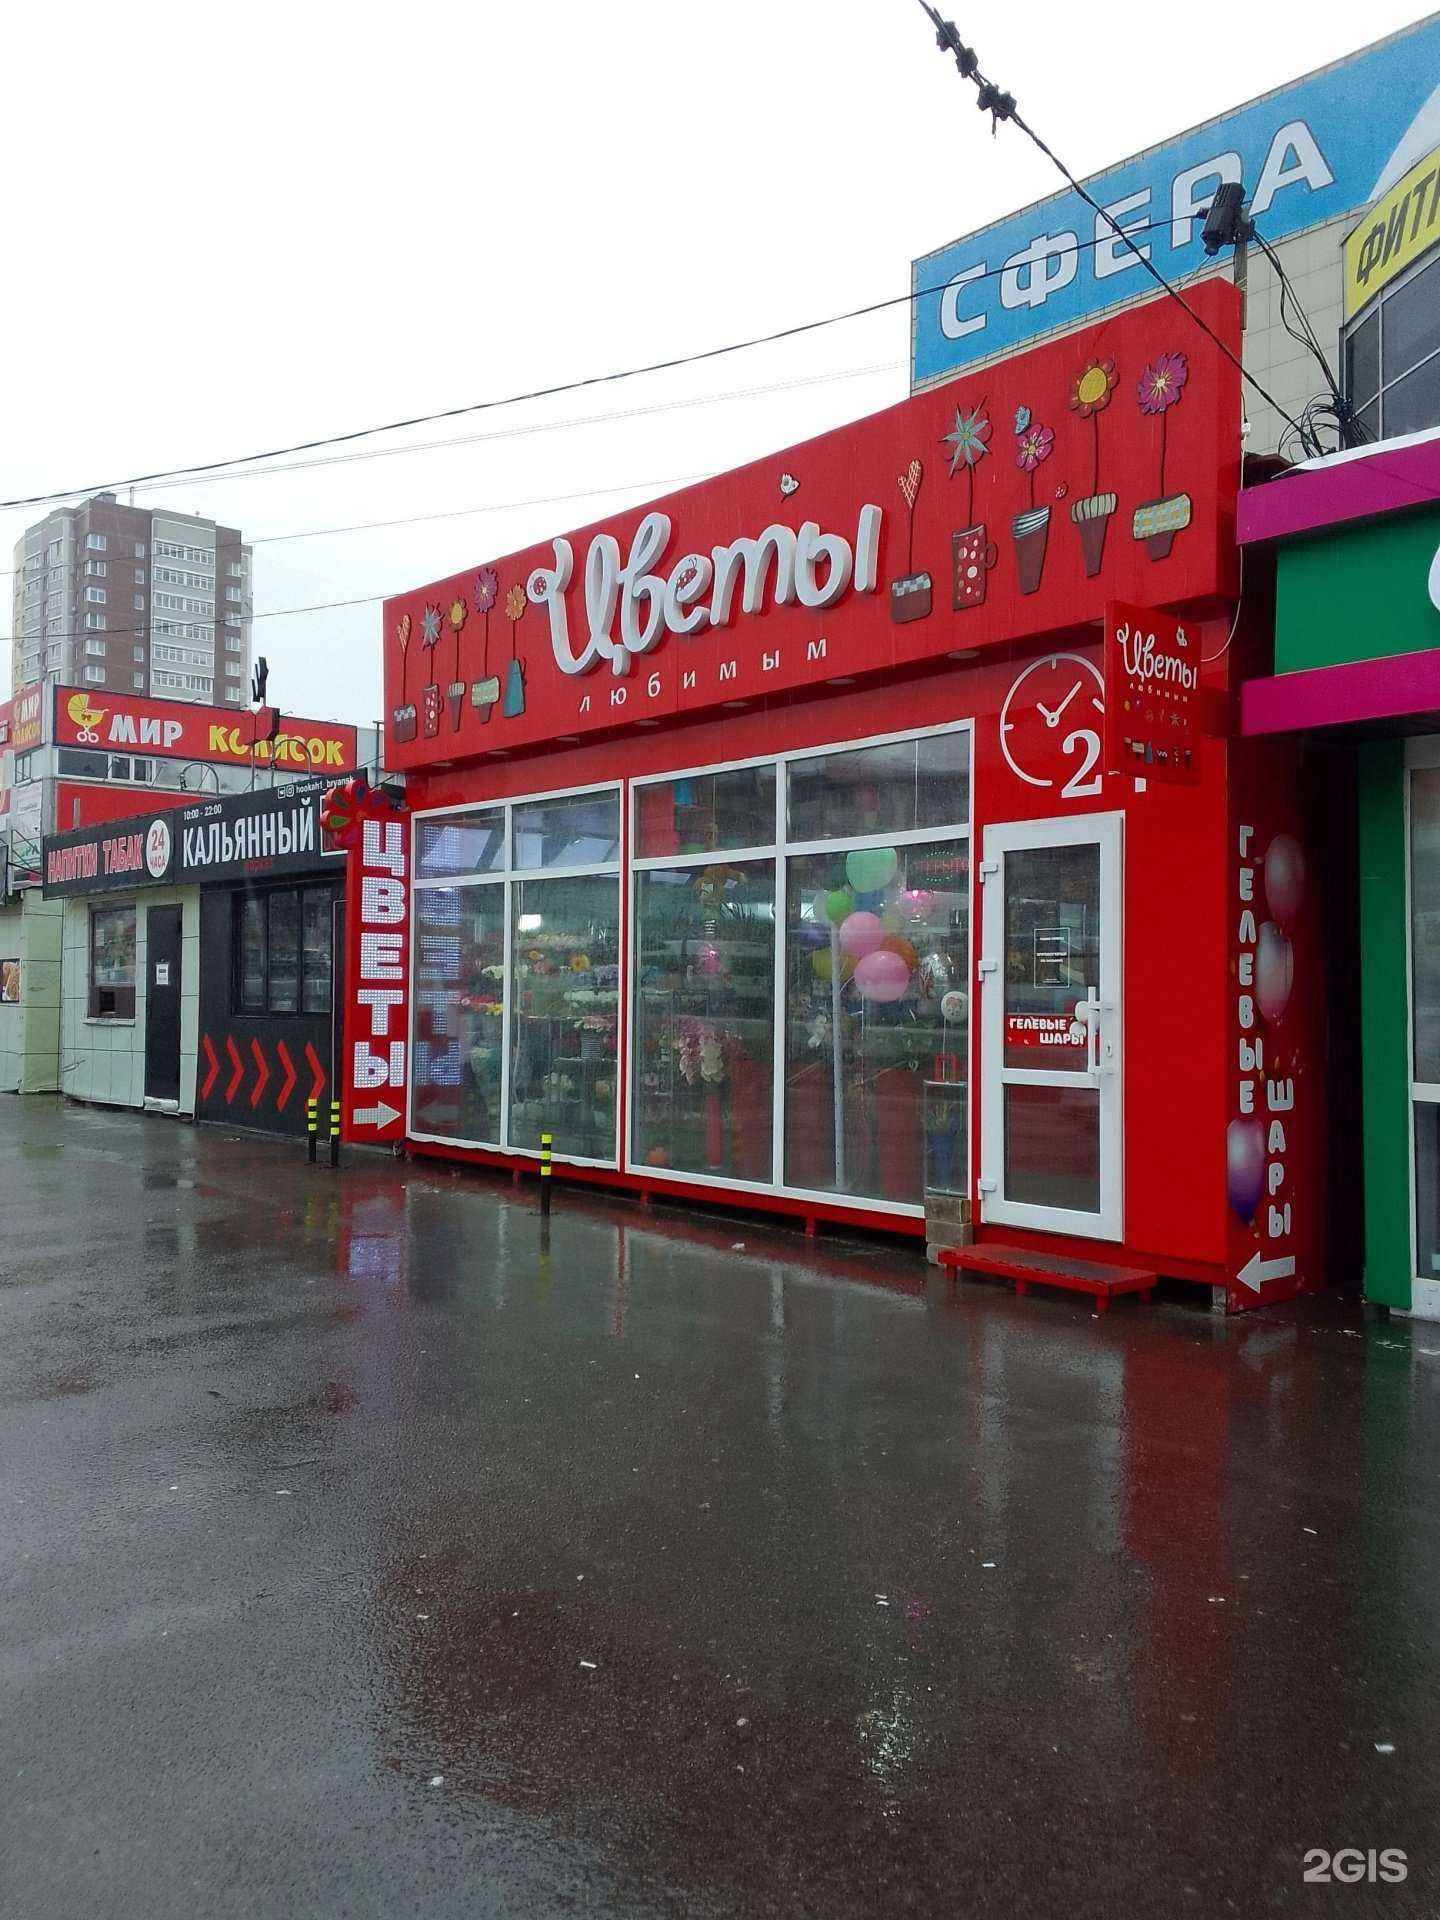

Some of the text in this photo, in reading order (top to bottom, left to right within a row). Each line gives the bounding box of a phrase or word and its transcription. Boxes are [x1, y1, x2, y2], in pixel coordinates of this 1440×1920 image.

[940, 119, 1335, 340] СФЕРА
[526, 503, 883, 677] Цветы
[1116, 621, 1198, 691] Цветы
[108, 713, 183, 748] МИР
[102, 833, 143, 875] ТАБАК
[151, 829, 165, 851] 24
[183, 797, 314, 868] КАЛЬЯННЫЙ
[353, 819, 405, 1089] ЦВЕТЫ
[1239, 825, 1263, 1113] ГЕЛЕВЫЕ
[1009, 1018, 1067, 1030] ГЕЛЕВЫЕ
[1040, 1032, 1084, 1045] ШАРЫ
[1267, 1078, 1295, 1238] ШАРЫ
